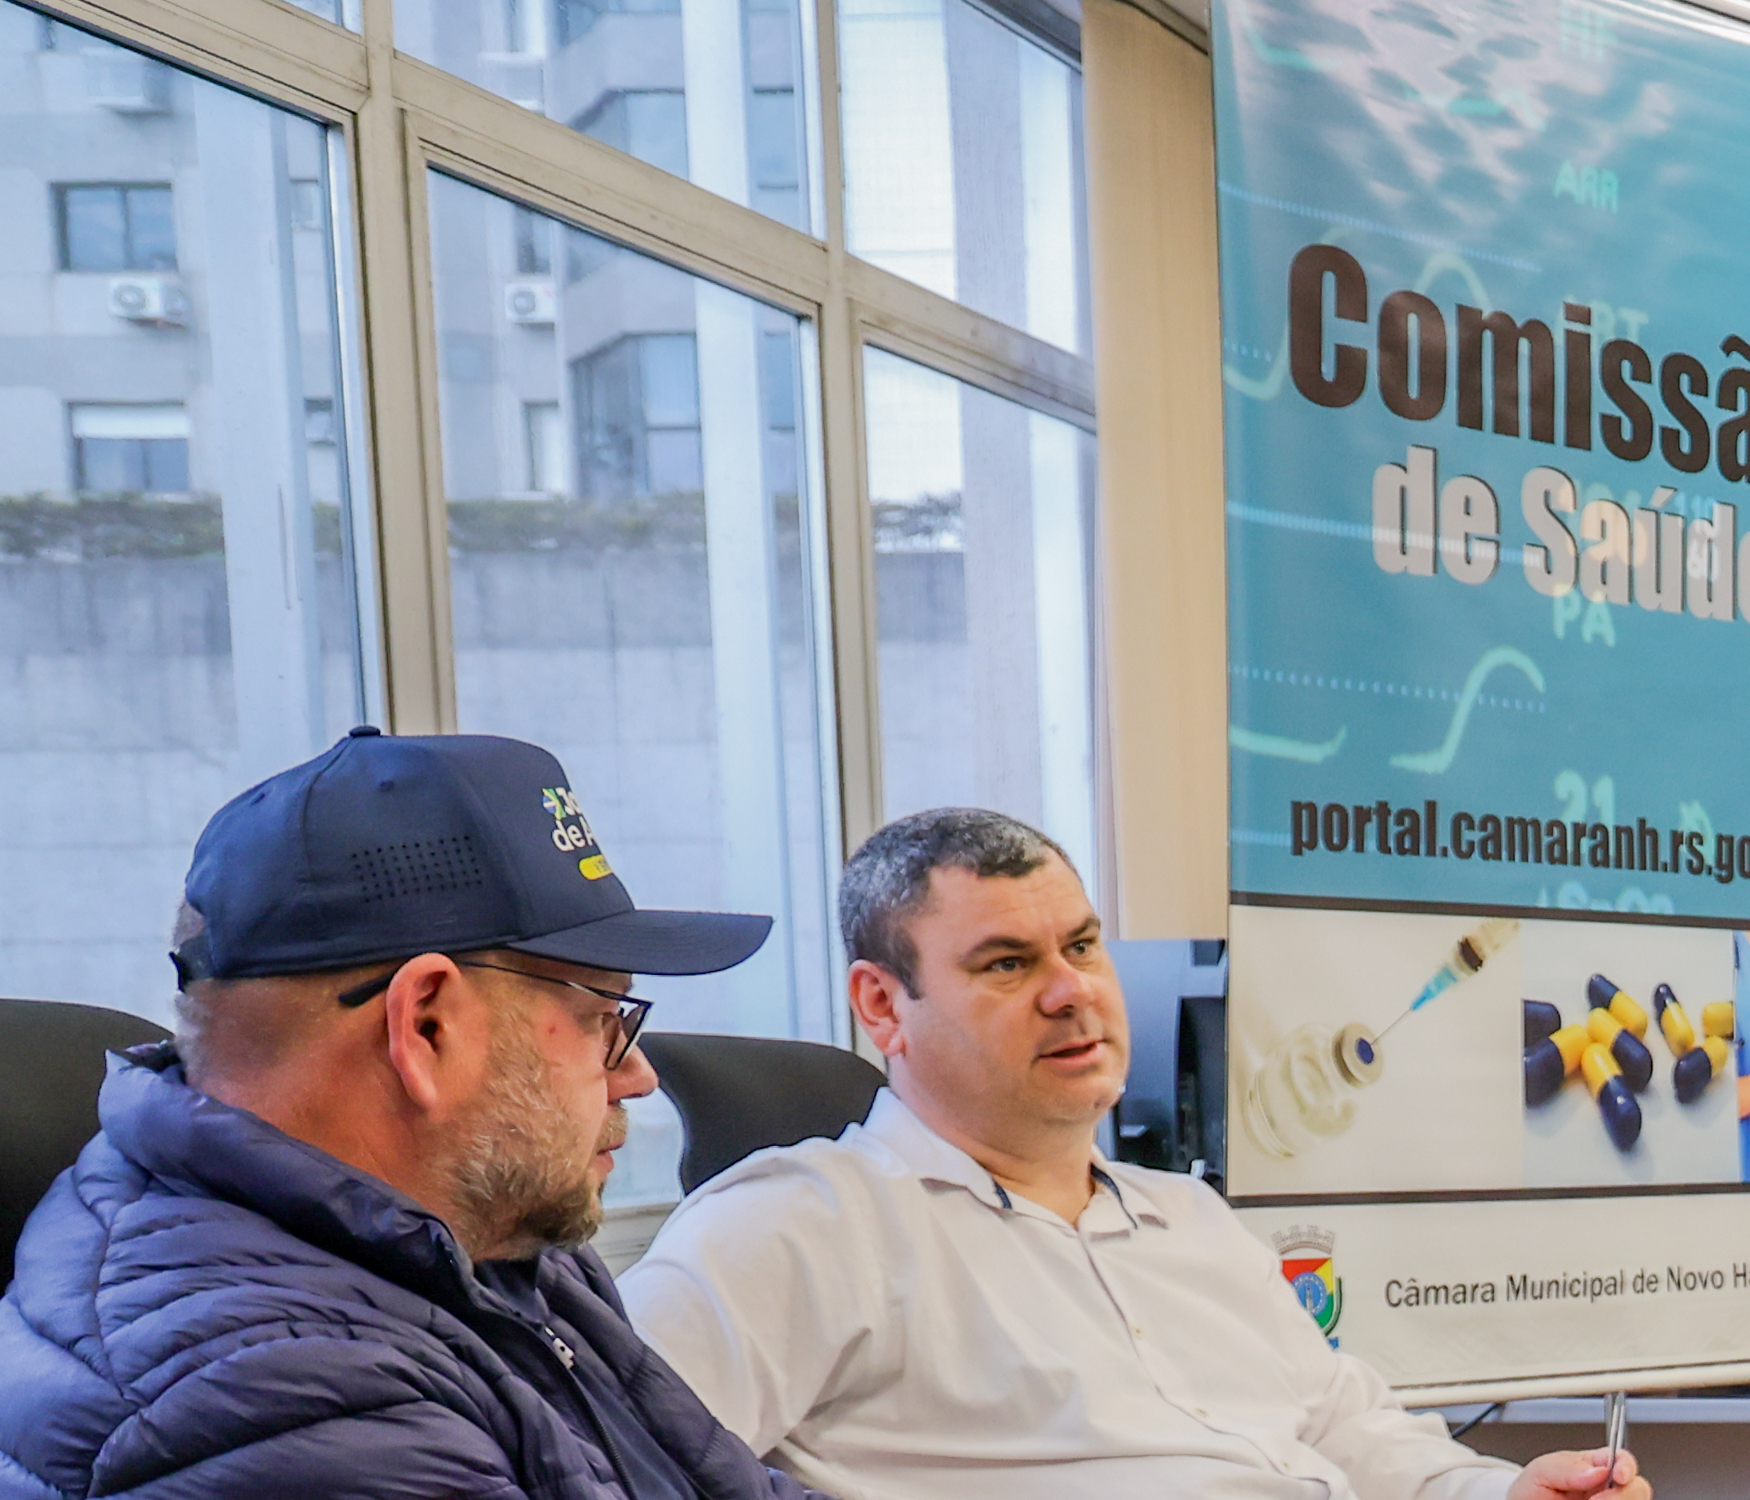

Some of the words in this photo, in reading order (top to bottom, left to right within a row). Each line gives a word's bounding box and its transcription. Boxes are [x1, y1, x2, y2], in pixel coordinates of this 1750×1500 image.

[1371, 445, 1501, 585] de
[552, 819, 586, 851] de
[1384, 1276, 1496, 1309] Câmara
[1505, 1268, 1624, 1304] Municipal
[1631, 1267, 1659, 1295] de
[1665, 1264, 1725, 1293] Novo
